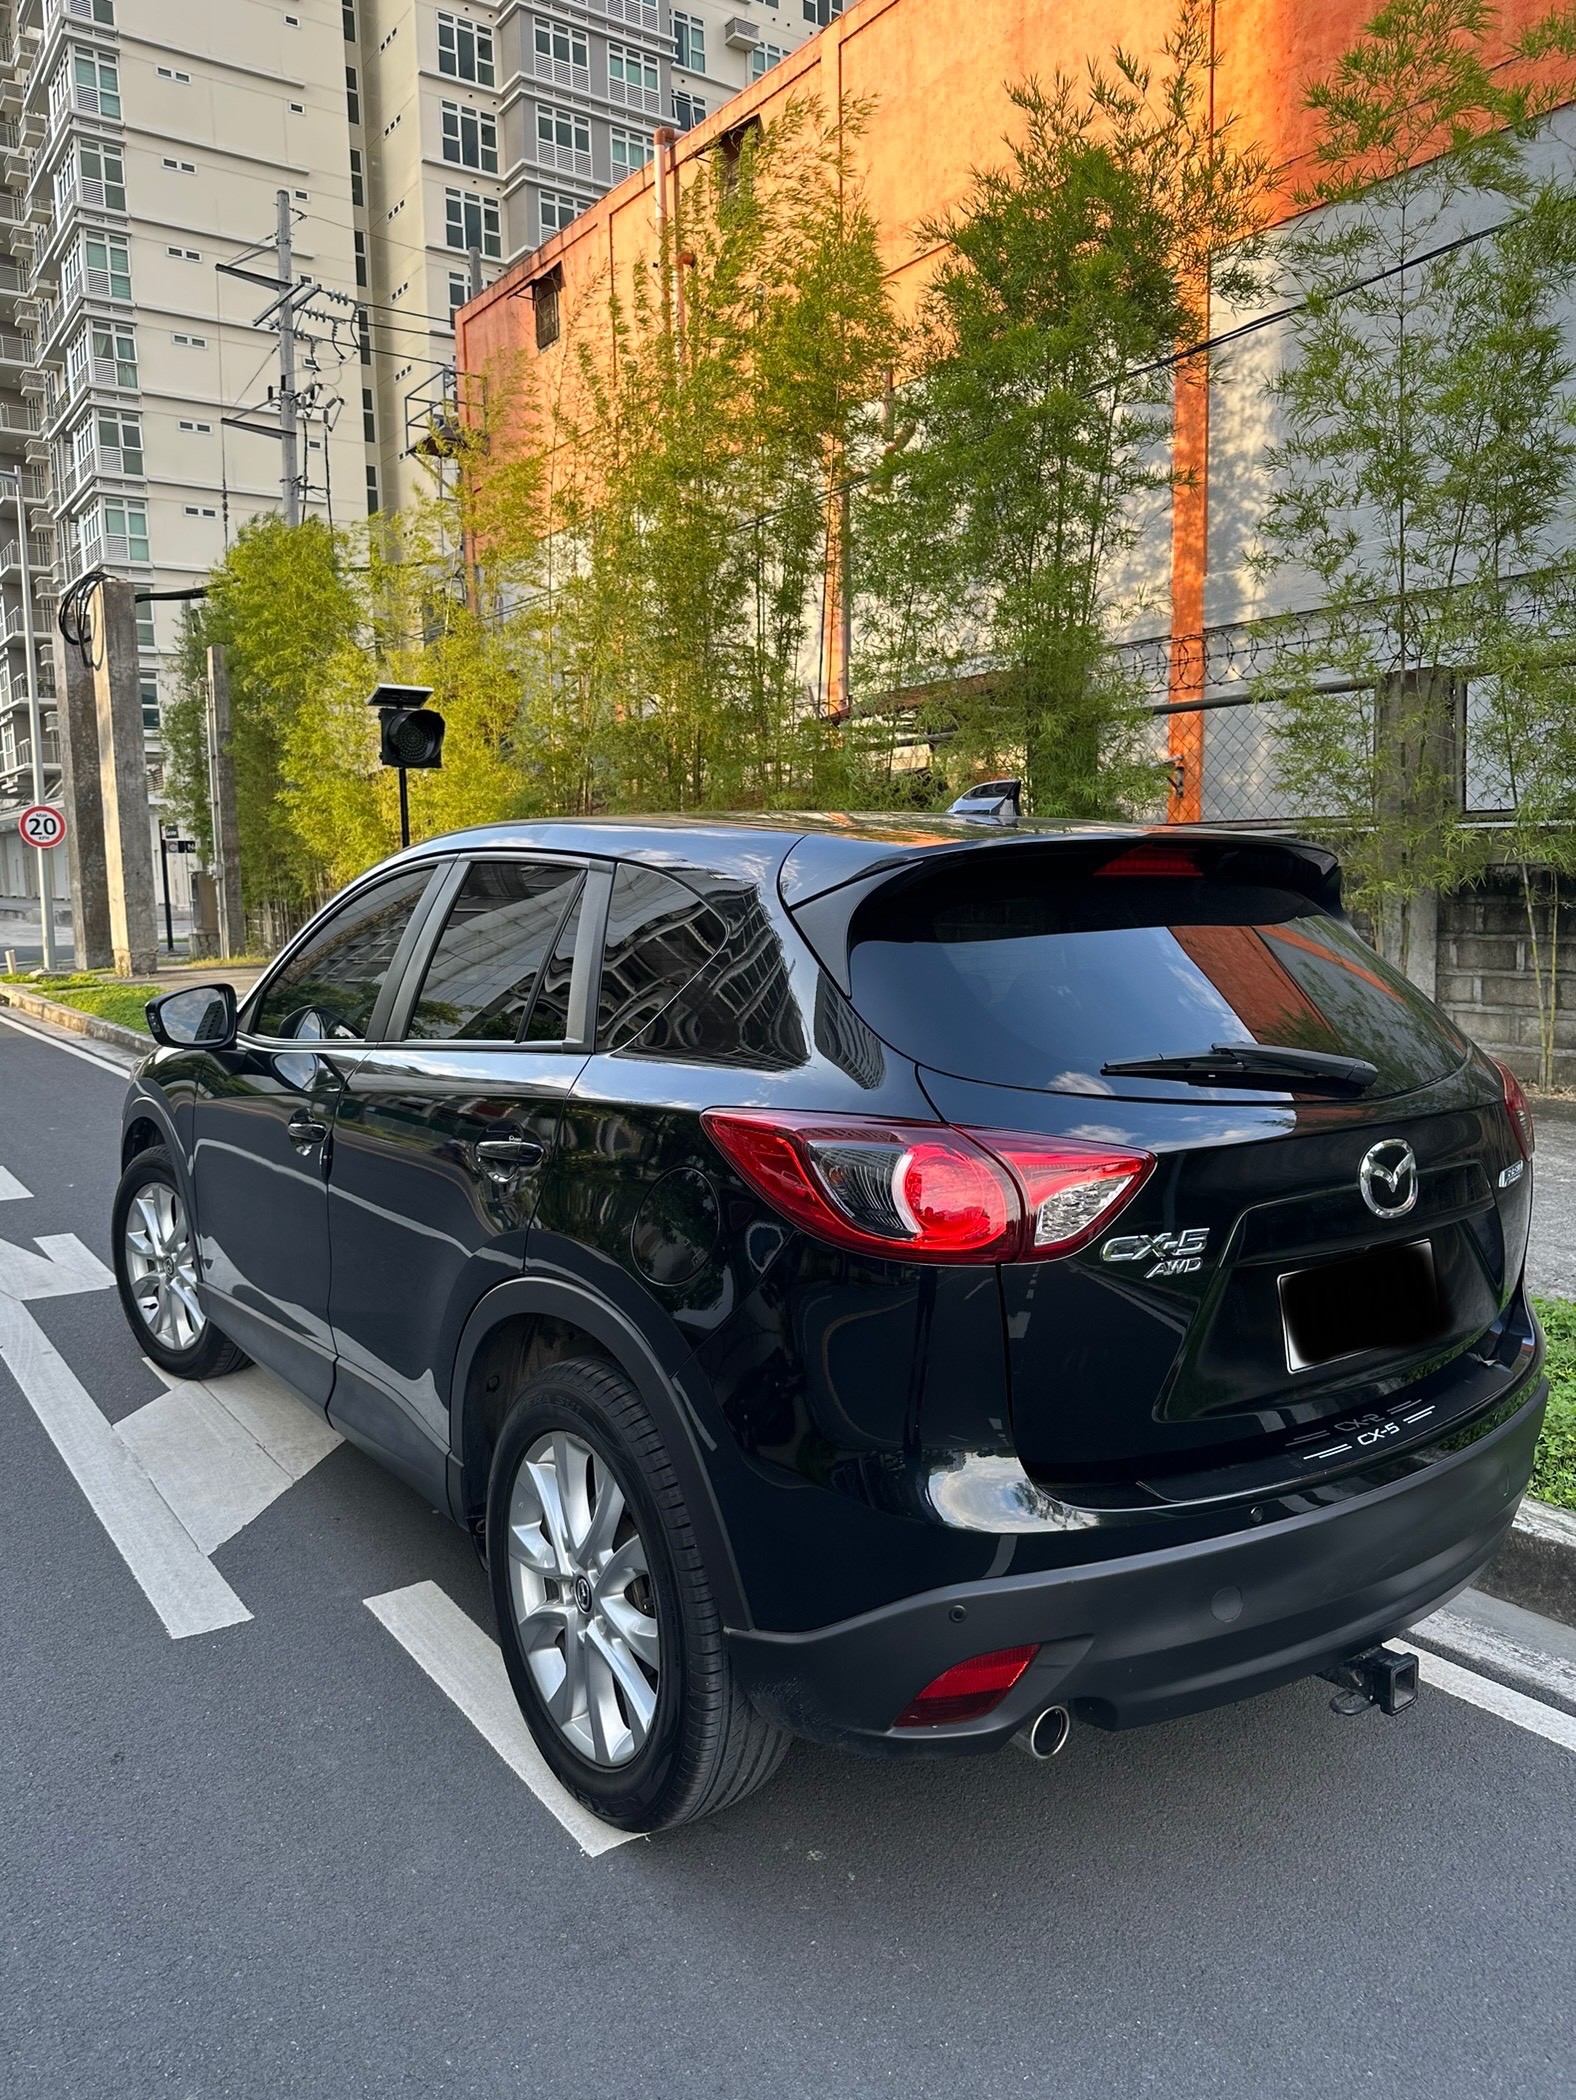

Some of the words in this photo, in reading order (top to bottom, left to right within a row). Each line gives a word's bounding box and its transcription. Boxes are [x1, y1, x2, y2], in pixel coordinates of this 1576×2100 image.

[29, 818, 57, 835] 20
[1100, 1227, 1210, 1262] CX-5
[1143, 1256, 1204, 1279] AWD
[1357, 1421, 1400, 1446] CX-5
